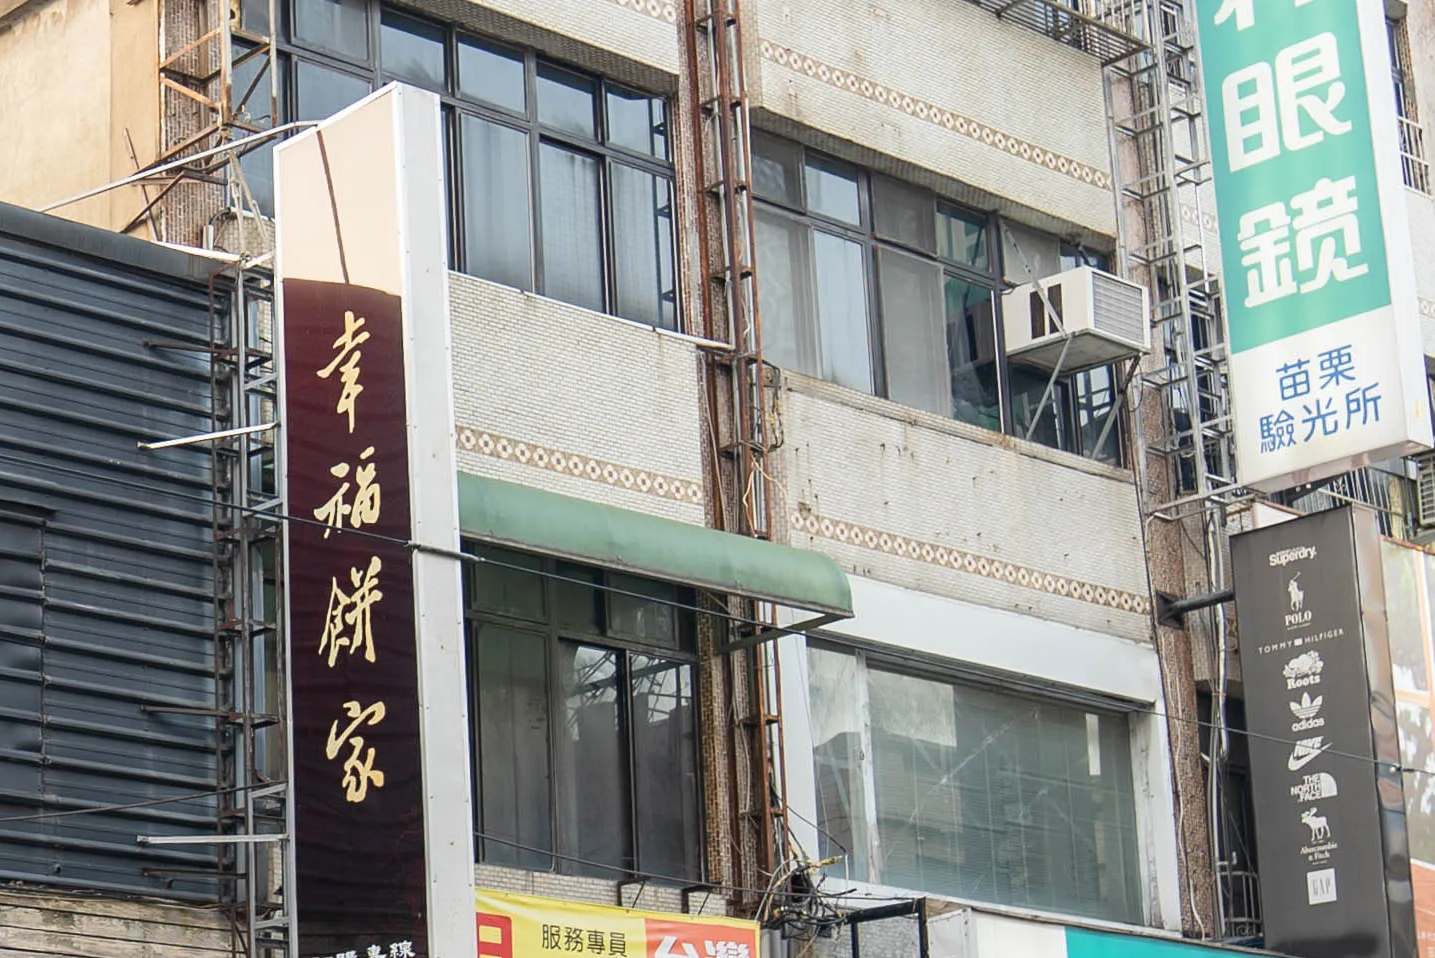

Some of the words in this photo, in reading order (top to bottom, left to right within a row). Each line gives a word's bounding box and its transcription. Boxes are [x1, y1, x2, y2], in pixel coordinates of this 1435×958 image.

[1214, 0, 1368, 308] 眼鏡
[1276, 344, 1356, 401] 苗栗
[1259, 382, 1382, 453] 驗光所
[314, 311, 385, 803] 幸福餅家
[1285, 610, 1312, 627] POLO
[1258, 640, 1293, 655] TOMMY
[1305, 628, 1345, 644] HILFIGER
[1287, 675, 1321, 690] Roots
[1291, 717, 1325, 732] adidas
[1312, 877, 1331, 896] GAP
[541, 924, 629, 958] 服務專員
